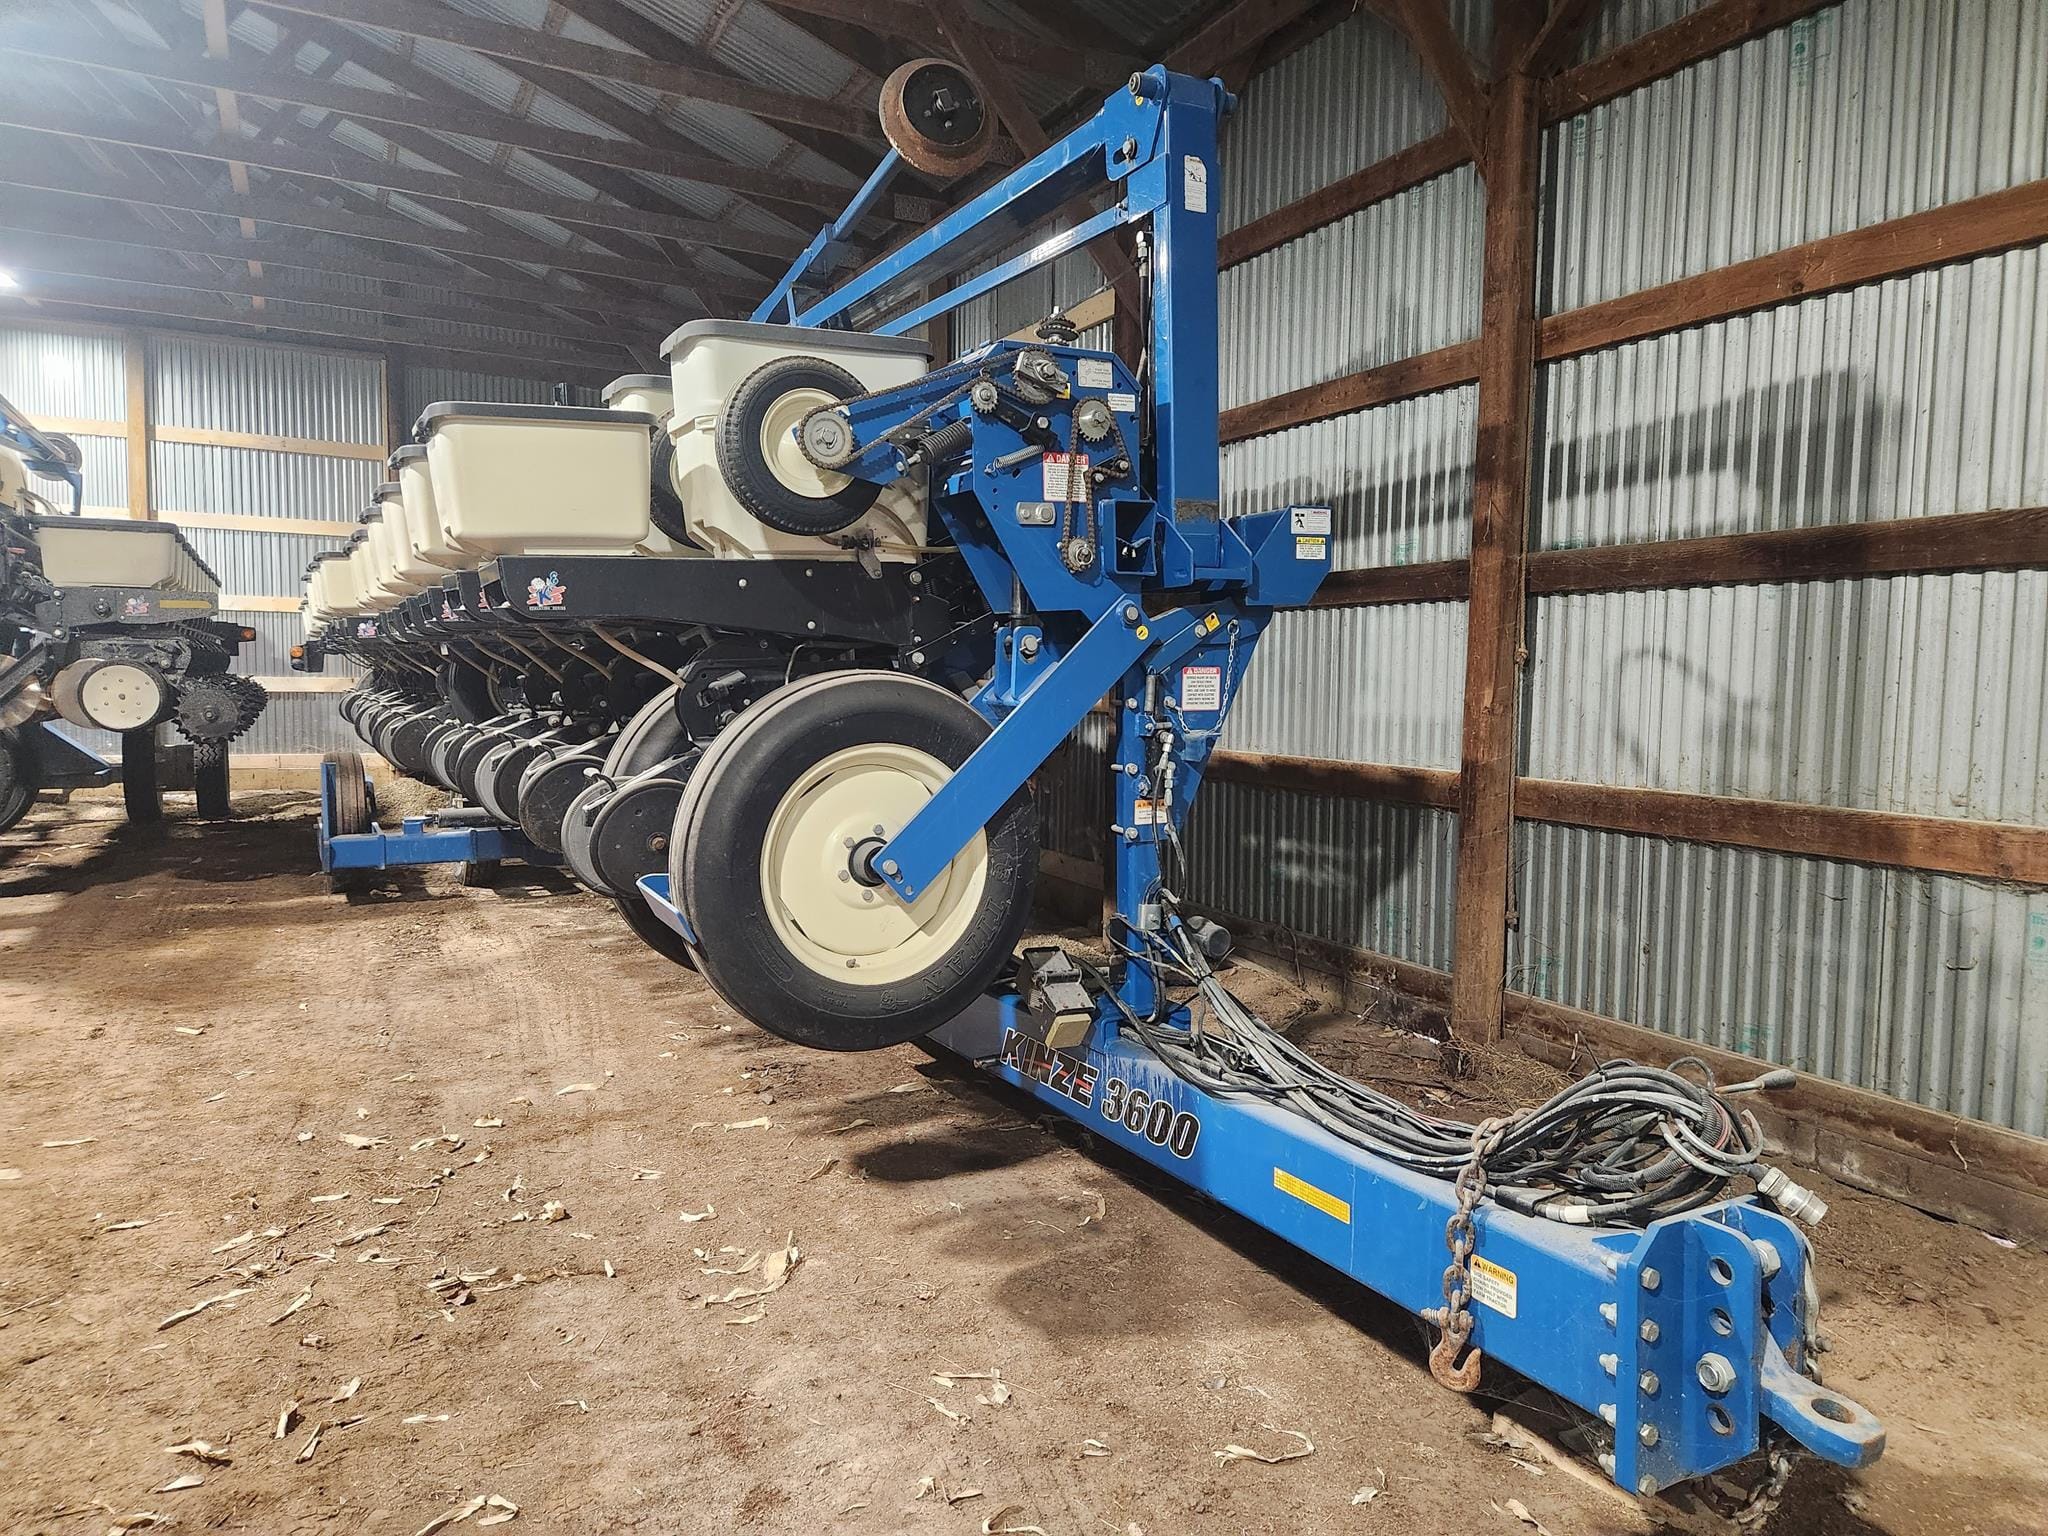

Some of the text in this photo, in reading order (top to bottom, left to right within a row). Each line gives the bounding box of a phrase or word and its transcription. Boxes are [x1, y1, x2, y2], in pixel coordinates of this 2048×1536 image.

[1056, 454, 1086, 464] DANER
[921, 896, 1004, 1000] TITAN
[1000, 1027, 1200, 1159] KINZE 3600
[1481, 1263, 1514, 1285] WARNING
